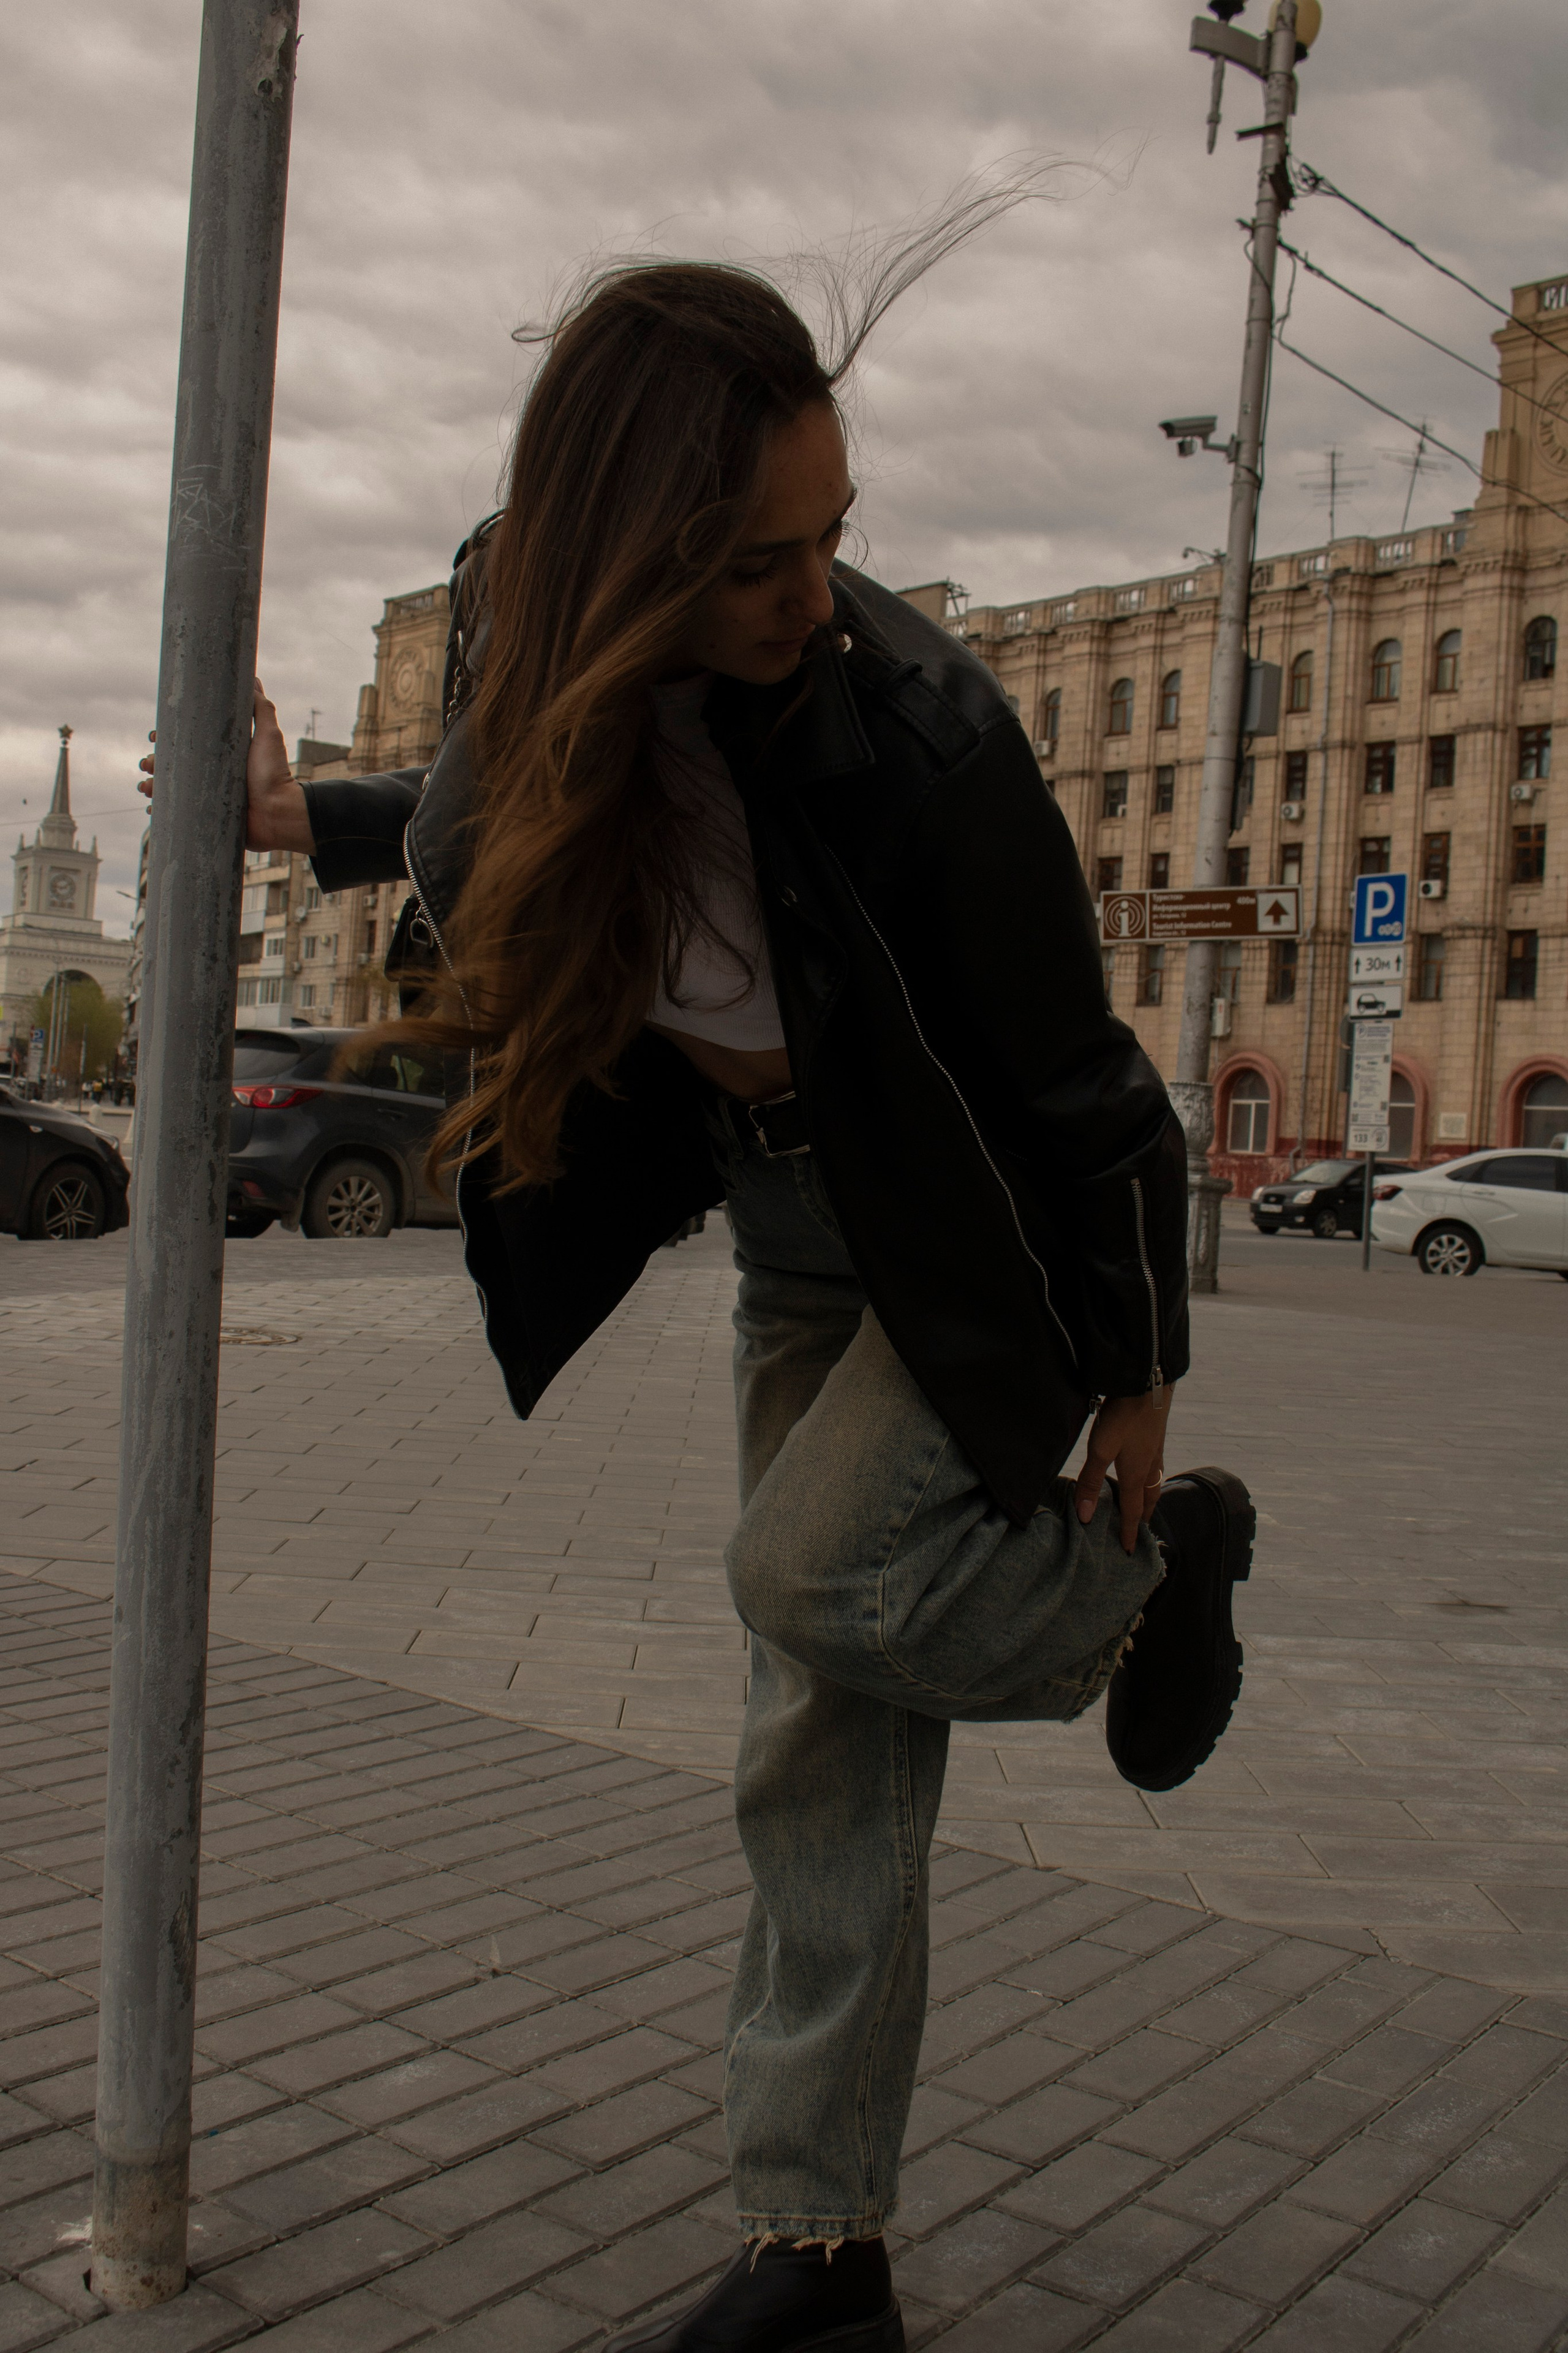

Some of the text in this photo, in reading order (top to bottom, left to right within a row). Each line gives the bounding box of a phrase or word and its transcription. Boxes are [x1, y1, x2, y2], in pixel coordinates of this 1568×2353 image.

[1152, 902, 1231, 913] Информационный центр
[1364, 881, 1395, 938] P
[1174, 921, 1210, 929] Information
[1211, 920, 1232, 929] Centre
